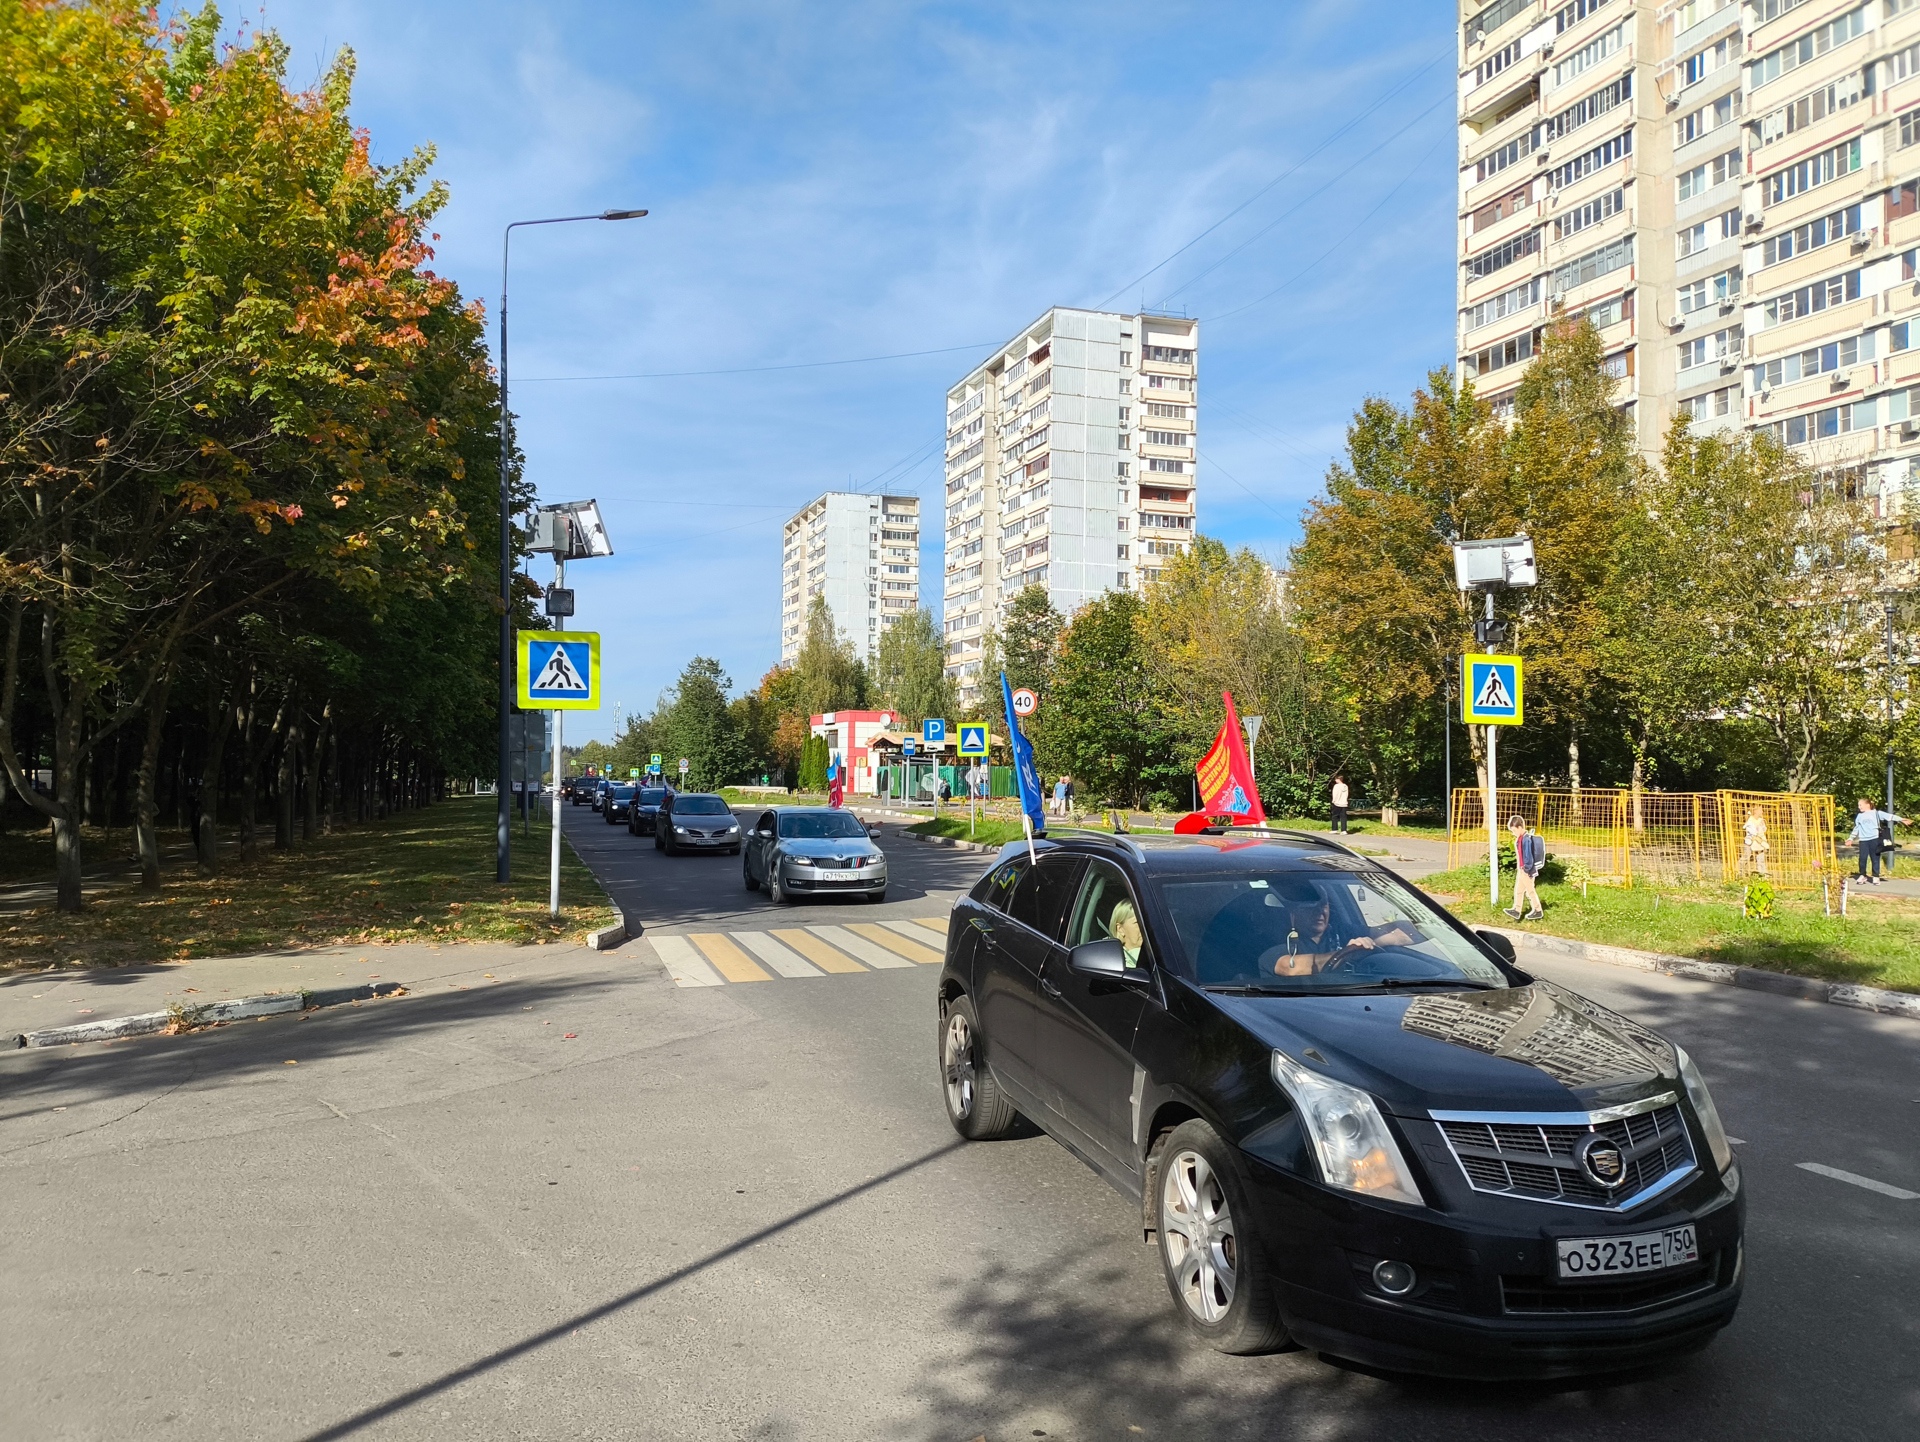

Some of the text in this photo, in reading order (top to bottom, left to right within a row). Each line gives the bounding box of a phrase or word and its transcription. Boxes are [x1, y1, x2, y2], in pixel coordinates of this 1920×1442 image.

[1014, 696, 1031, 708] 40
[929, 721, 941, 739] P
[1664, 1229, 1691, 1254] 750
[1672, 1253, 1687, 1262] RUS
